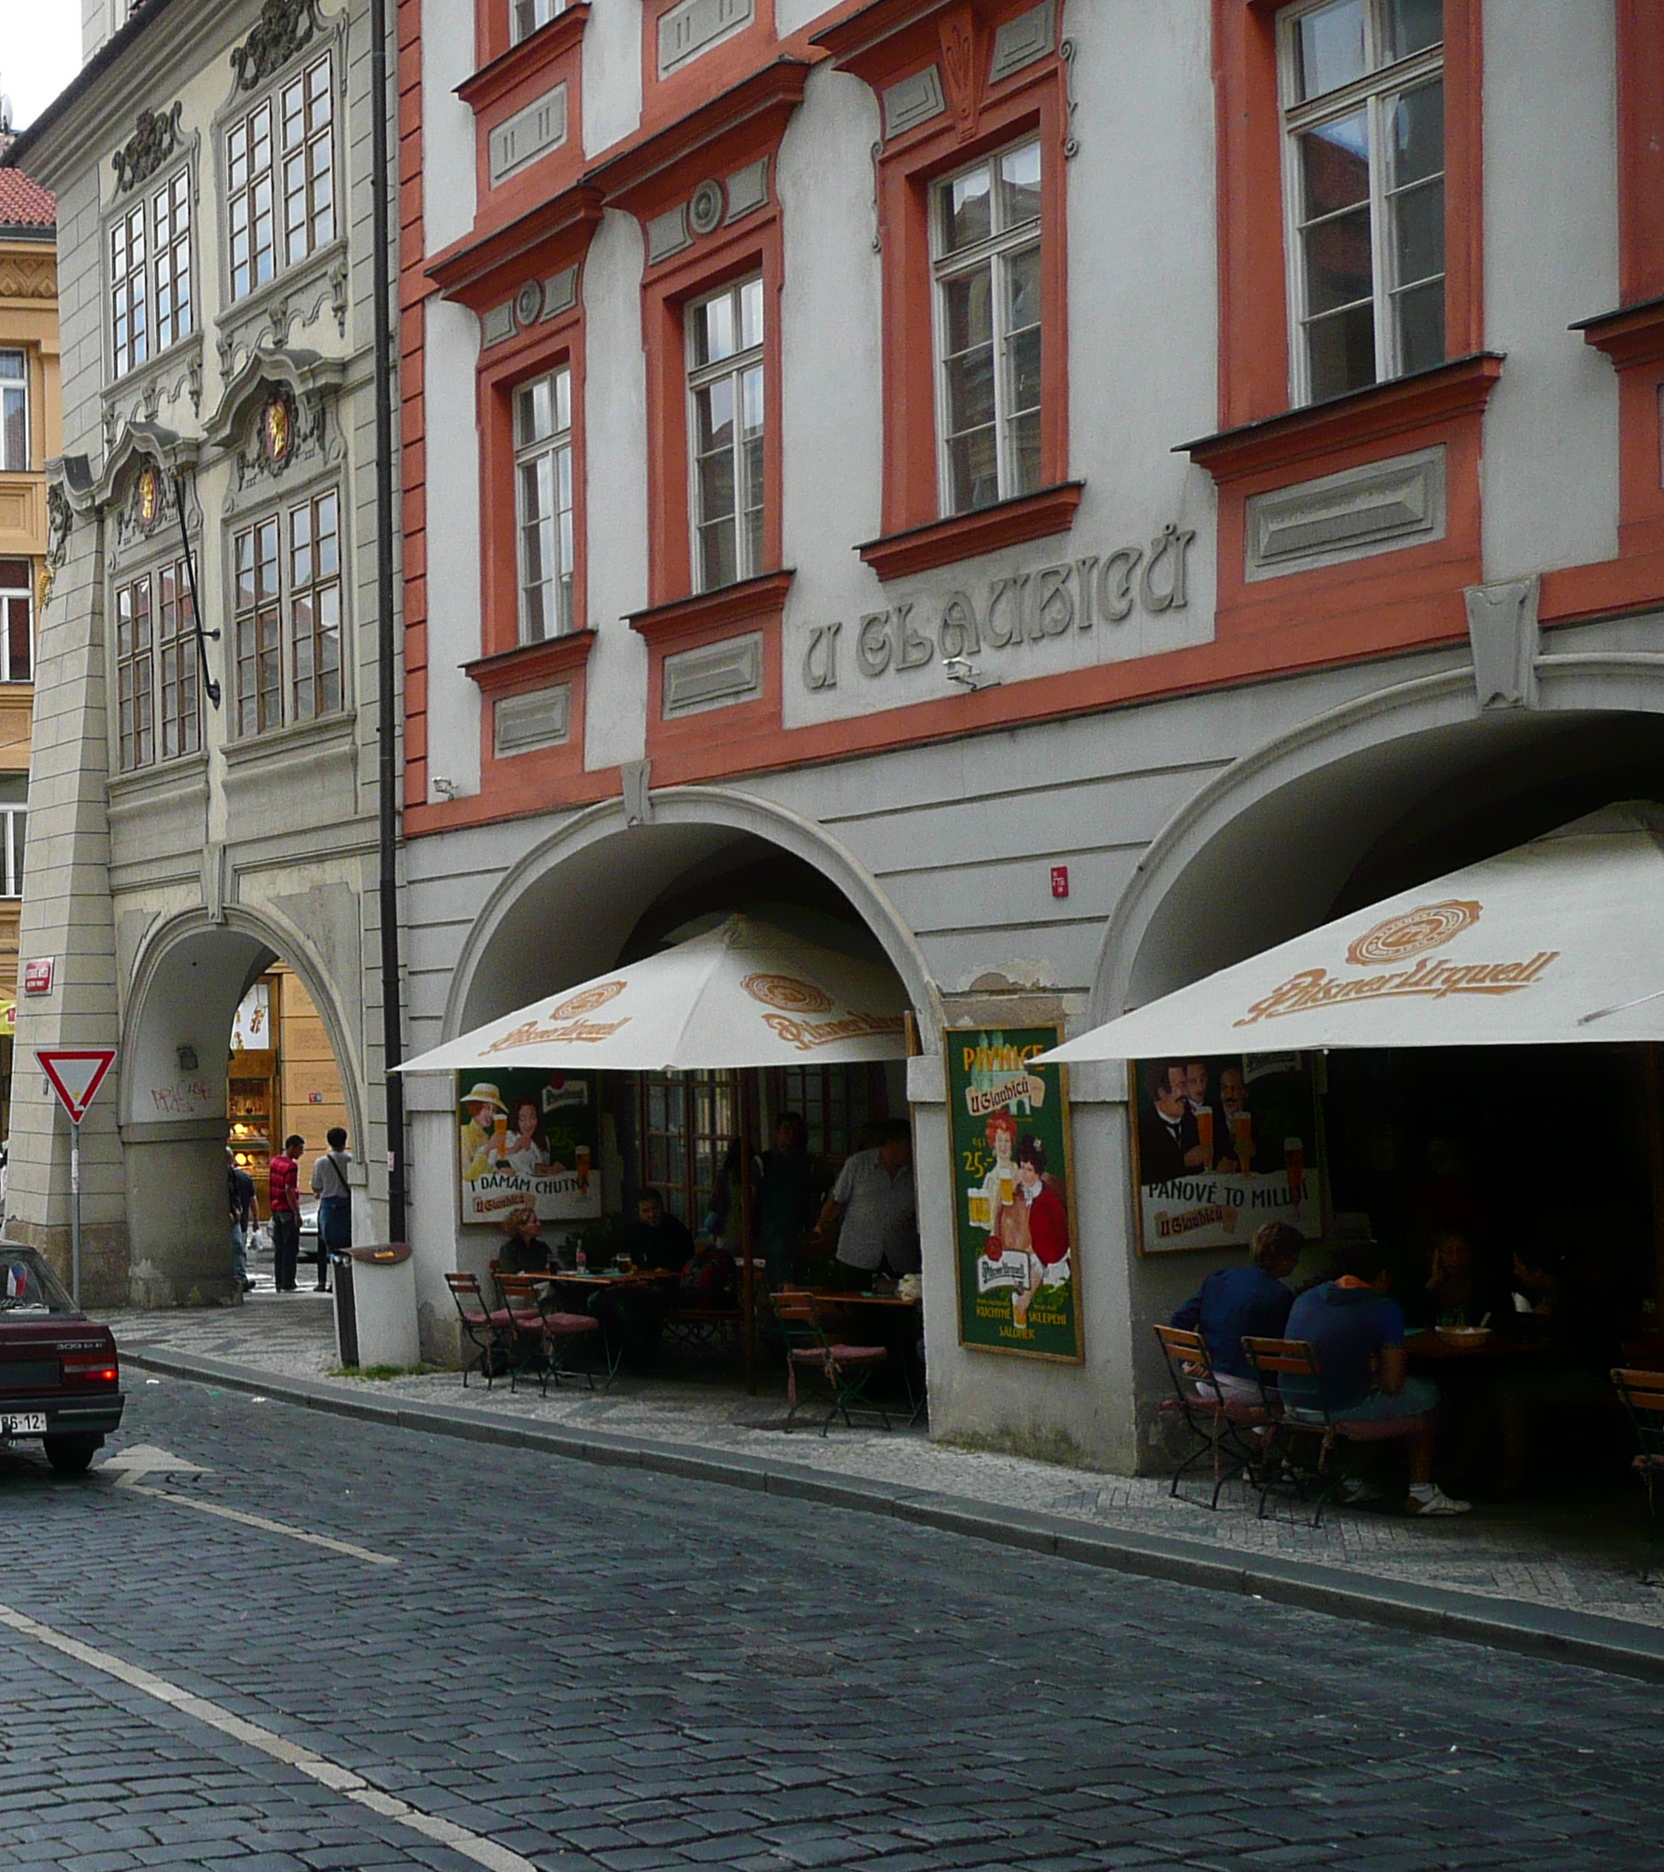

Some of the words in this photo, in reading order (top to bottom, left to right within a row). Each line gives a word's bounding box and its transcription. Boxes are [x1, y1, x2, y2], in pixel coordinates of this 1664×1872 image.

[802, 622, 844, 690] U
[1231, 967, 1401, 1029] Pilsner
[480, 1172, 531, 1192] DÁMÁM
[1225, 1187, 1245, 1208] TO
